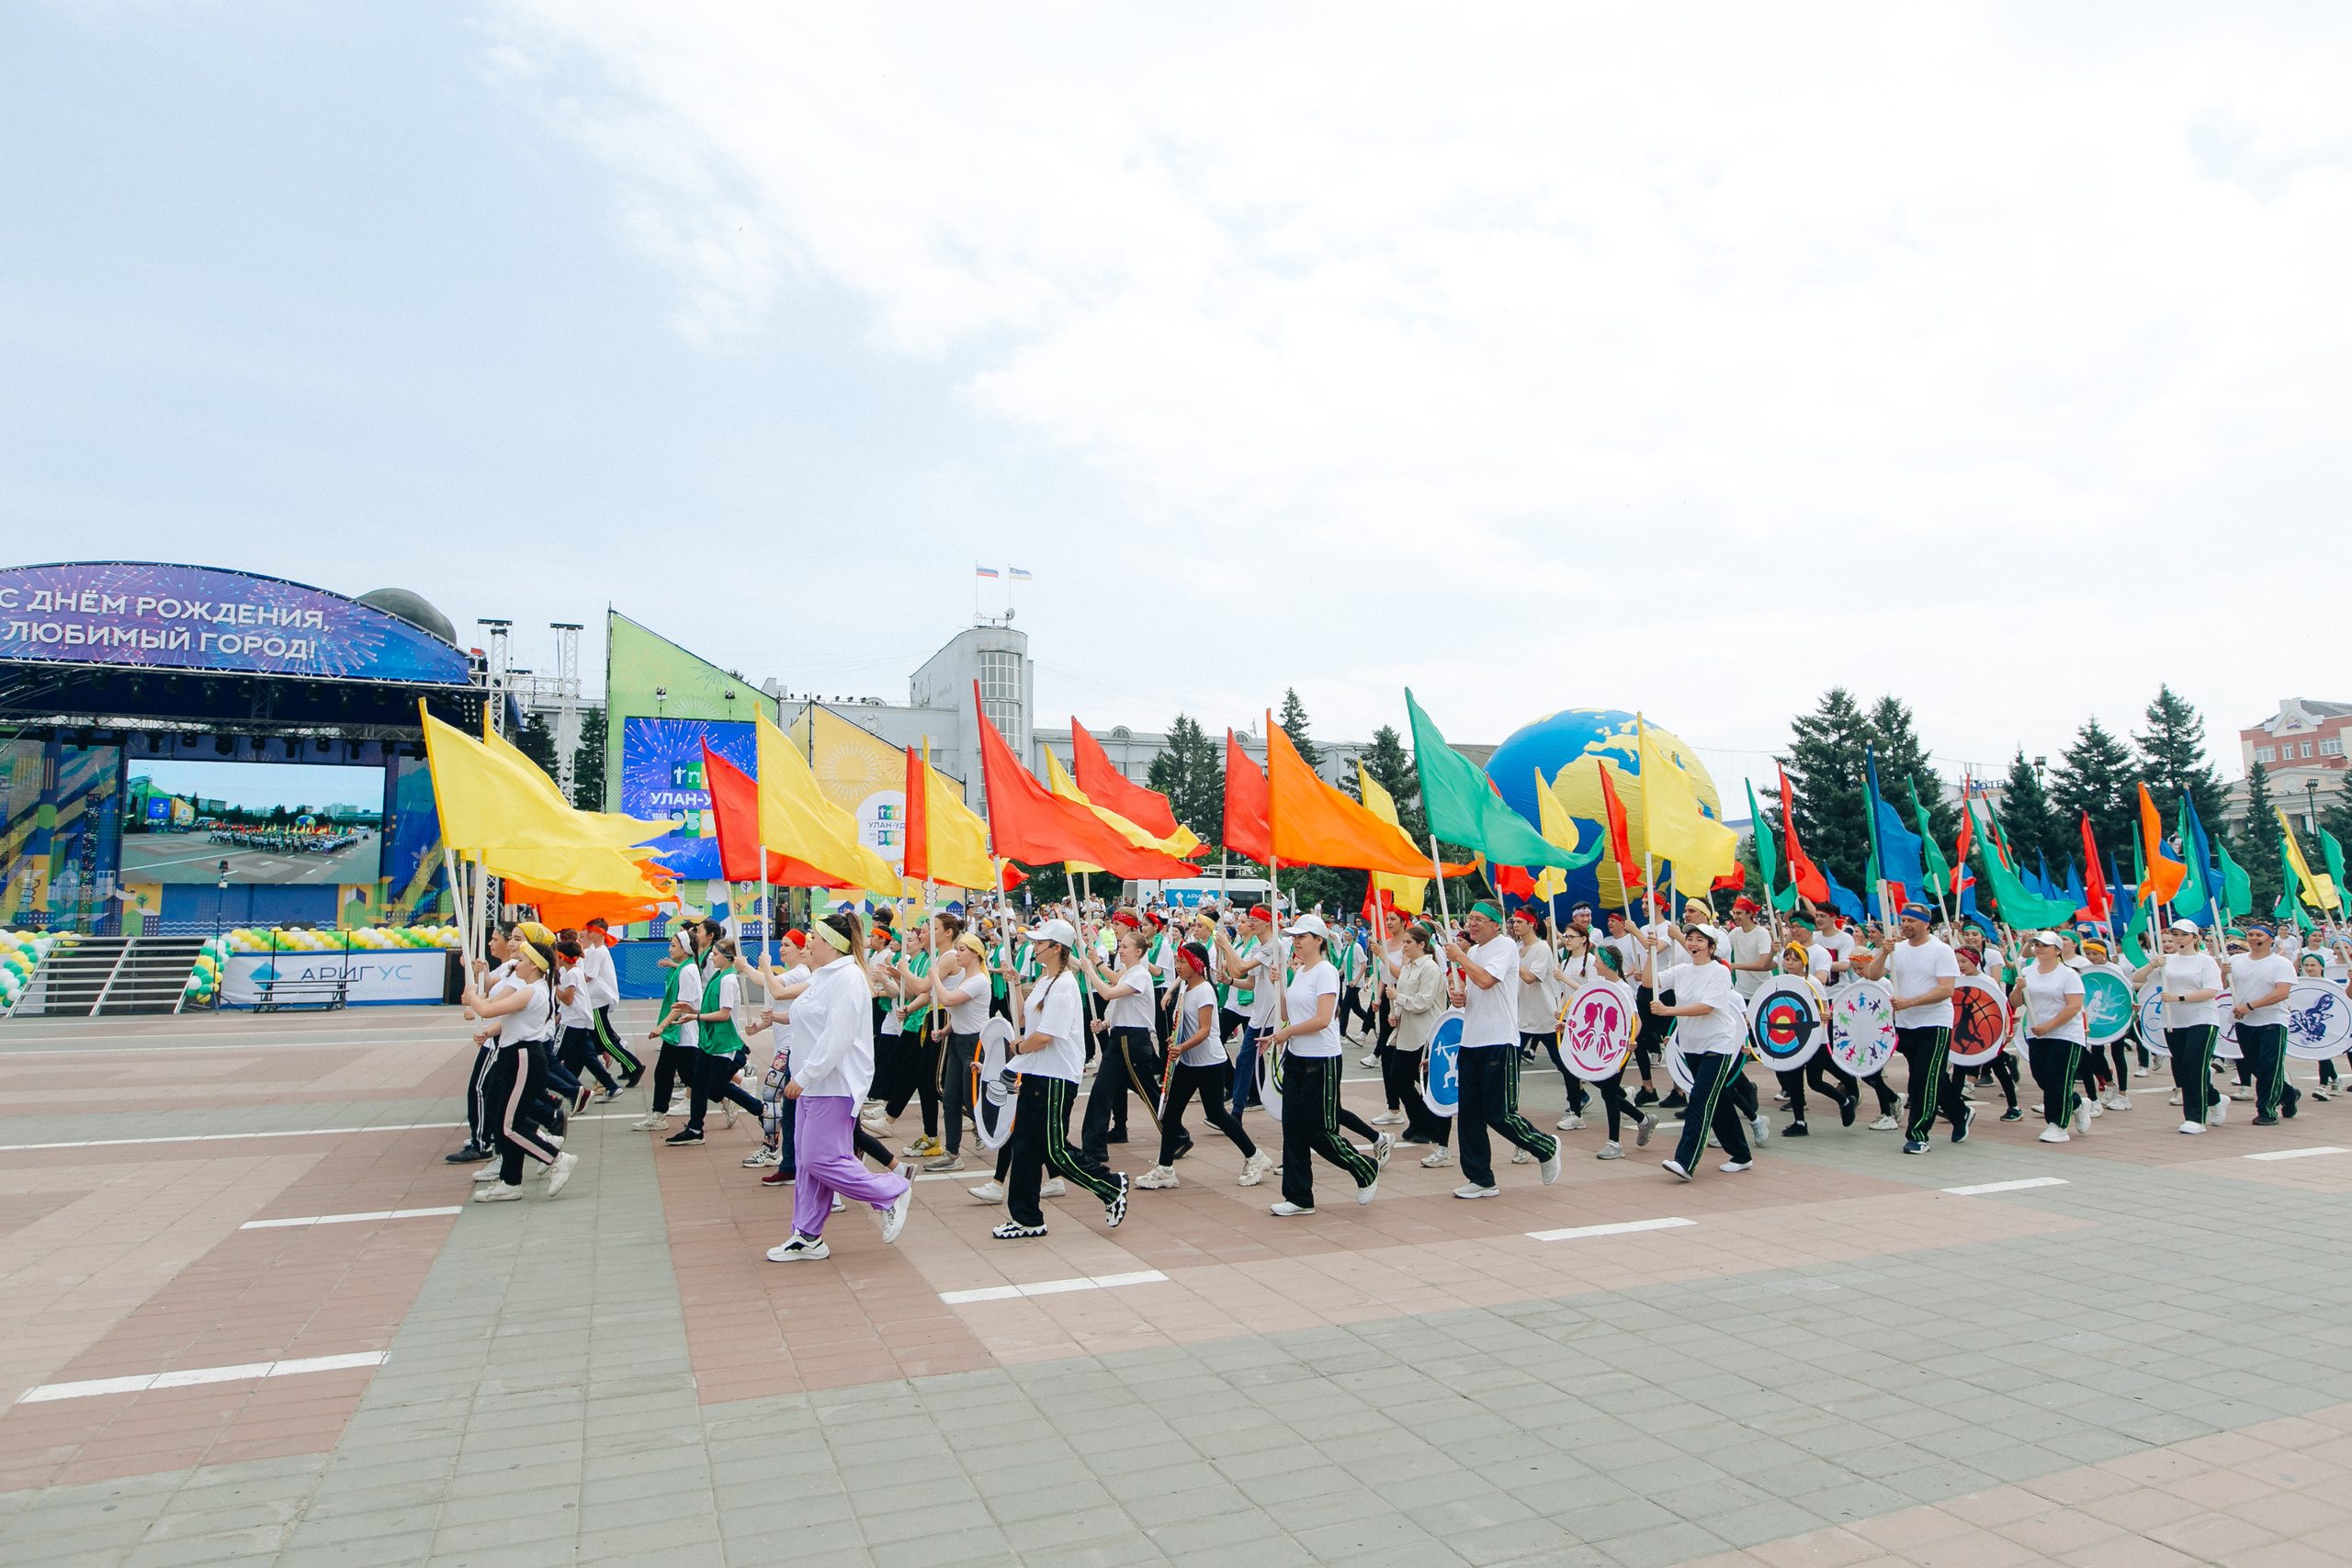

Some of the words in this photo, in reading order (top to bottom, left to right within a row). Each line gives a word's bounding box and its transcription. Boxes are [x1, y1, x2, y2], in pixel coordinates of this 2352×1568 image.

[0, 588, 20, 608] С
[26, 589, 129, 615] ДНЁМ
[136, 596, 330, 633] РОЖДЕНИЯ,
[4, 620, 191, 650] ЛЮБИМЫЙ
[199, 632, 317, 661] ГОРОД!
[300, 964, 413, 981] АРИГУС
